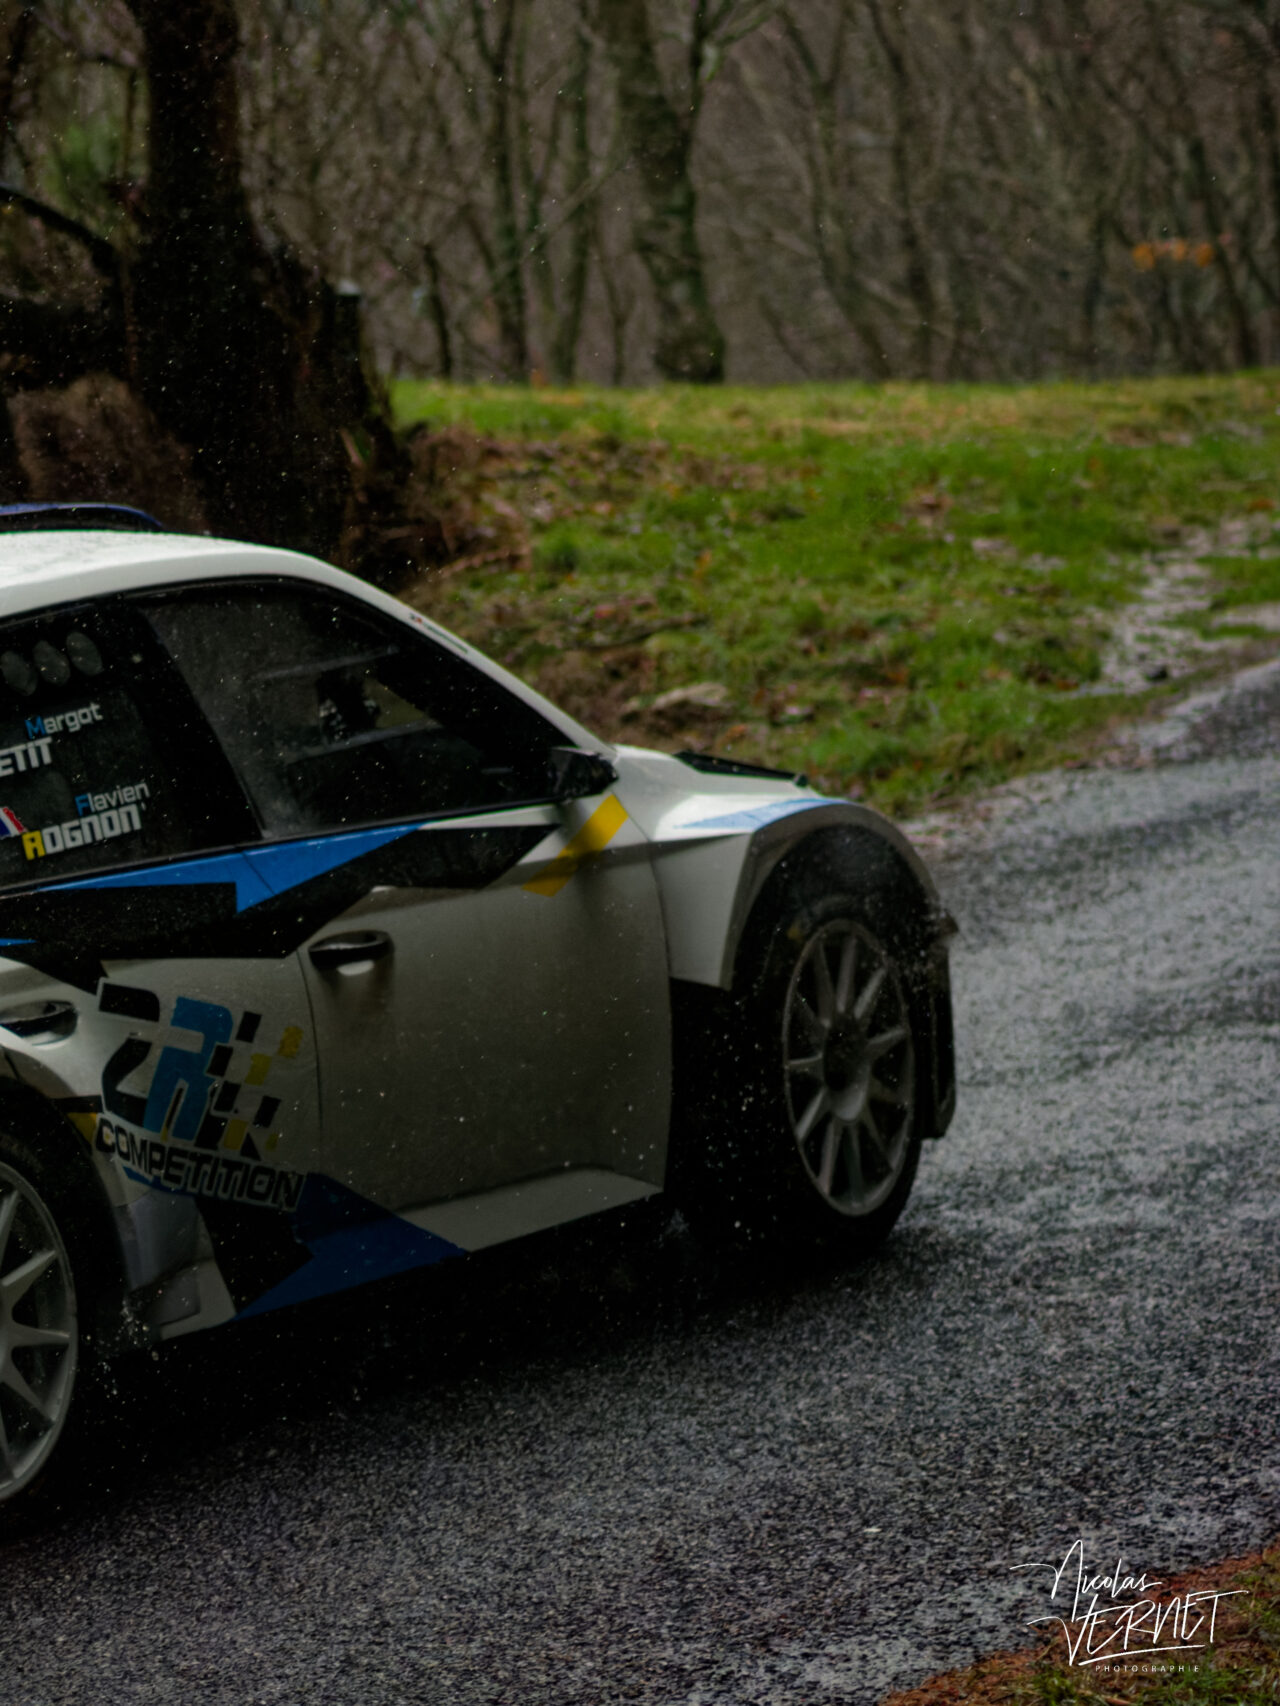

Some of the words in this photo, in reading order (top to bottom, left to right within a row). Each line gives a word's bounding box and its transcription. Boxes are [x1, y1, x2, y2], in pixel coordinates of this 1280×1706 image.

[24, 702, 104, 739] Margot
[74, 782, 151, 817] Flavien
[21, 804, 143, 861] ROGNON
[95, 1118, 306, 1209] COMPETITION
